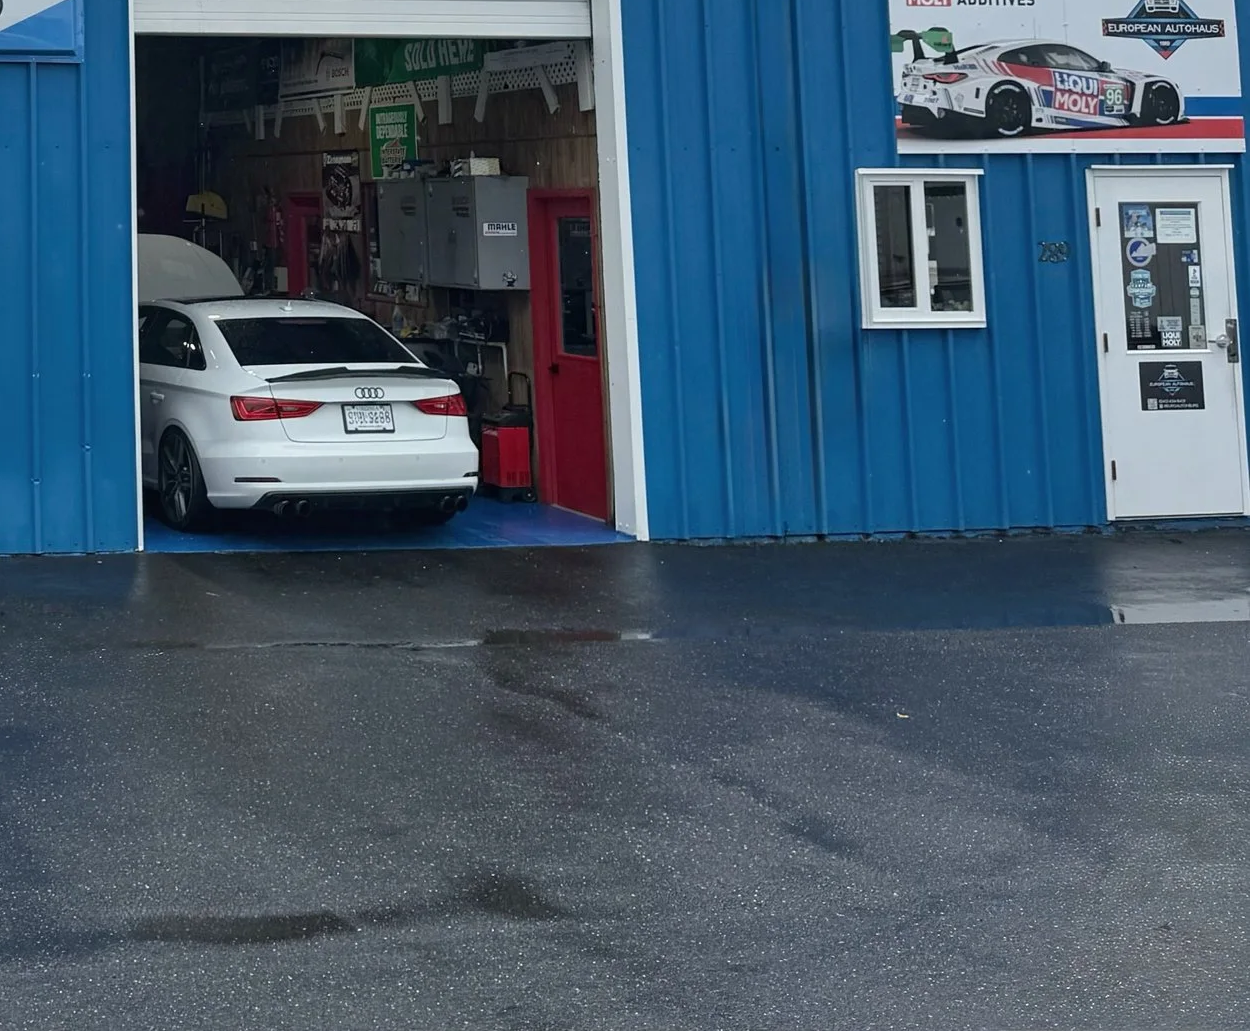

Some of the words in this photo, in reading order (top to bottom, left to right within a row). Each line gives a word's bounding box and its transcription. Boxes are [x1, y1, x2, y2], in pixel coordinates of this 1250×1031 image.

[1107, 23, 1164, 33] EUROPEAN
[1165, 24, 1220, 34] AUTOHAUS
[404, 40, 437, 71] SOLD
[1054, 71, 1098, 96] LIQUI
[1054, 91, 1098, 115] MOLY
[1105, 88, 1123, 106] 96
[487, 223, 516, 231] MAHLE
[1162, 331, 1181, 339] LIQUI
[1162, 339, 1181, 347] MOLY
